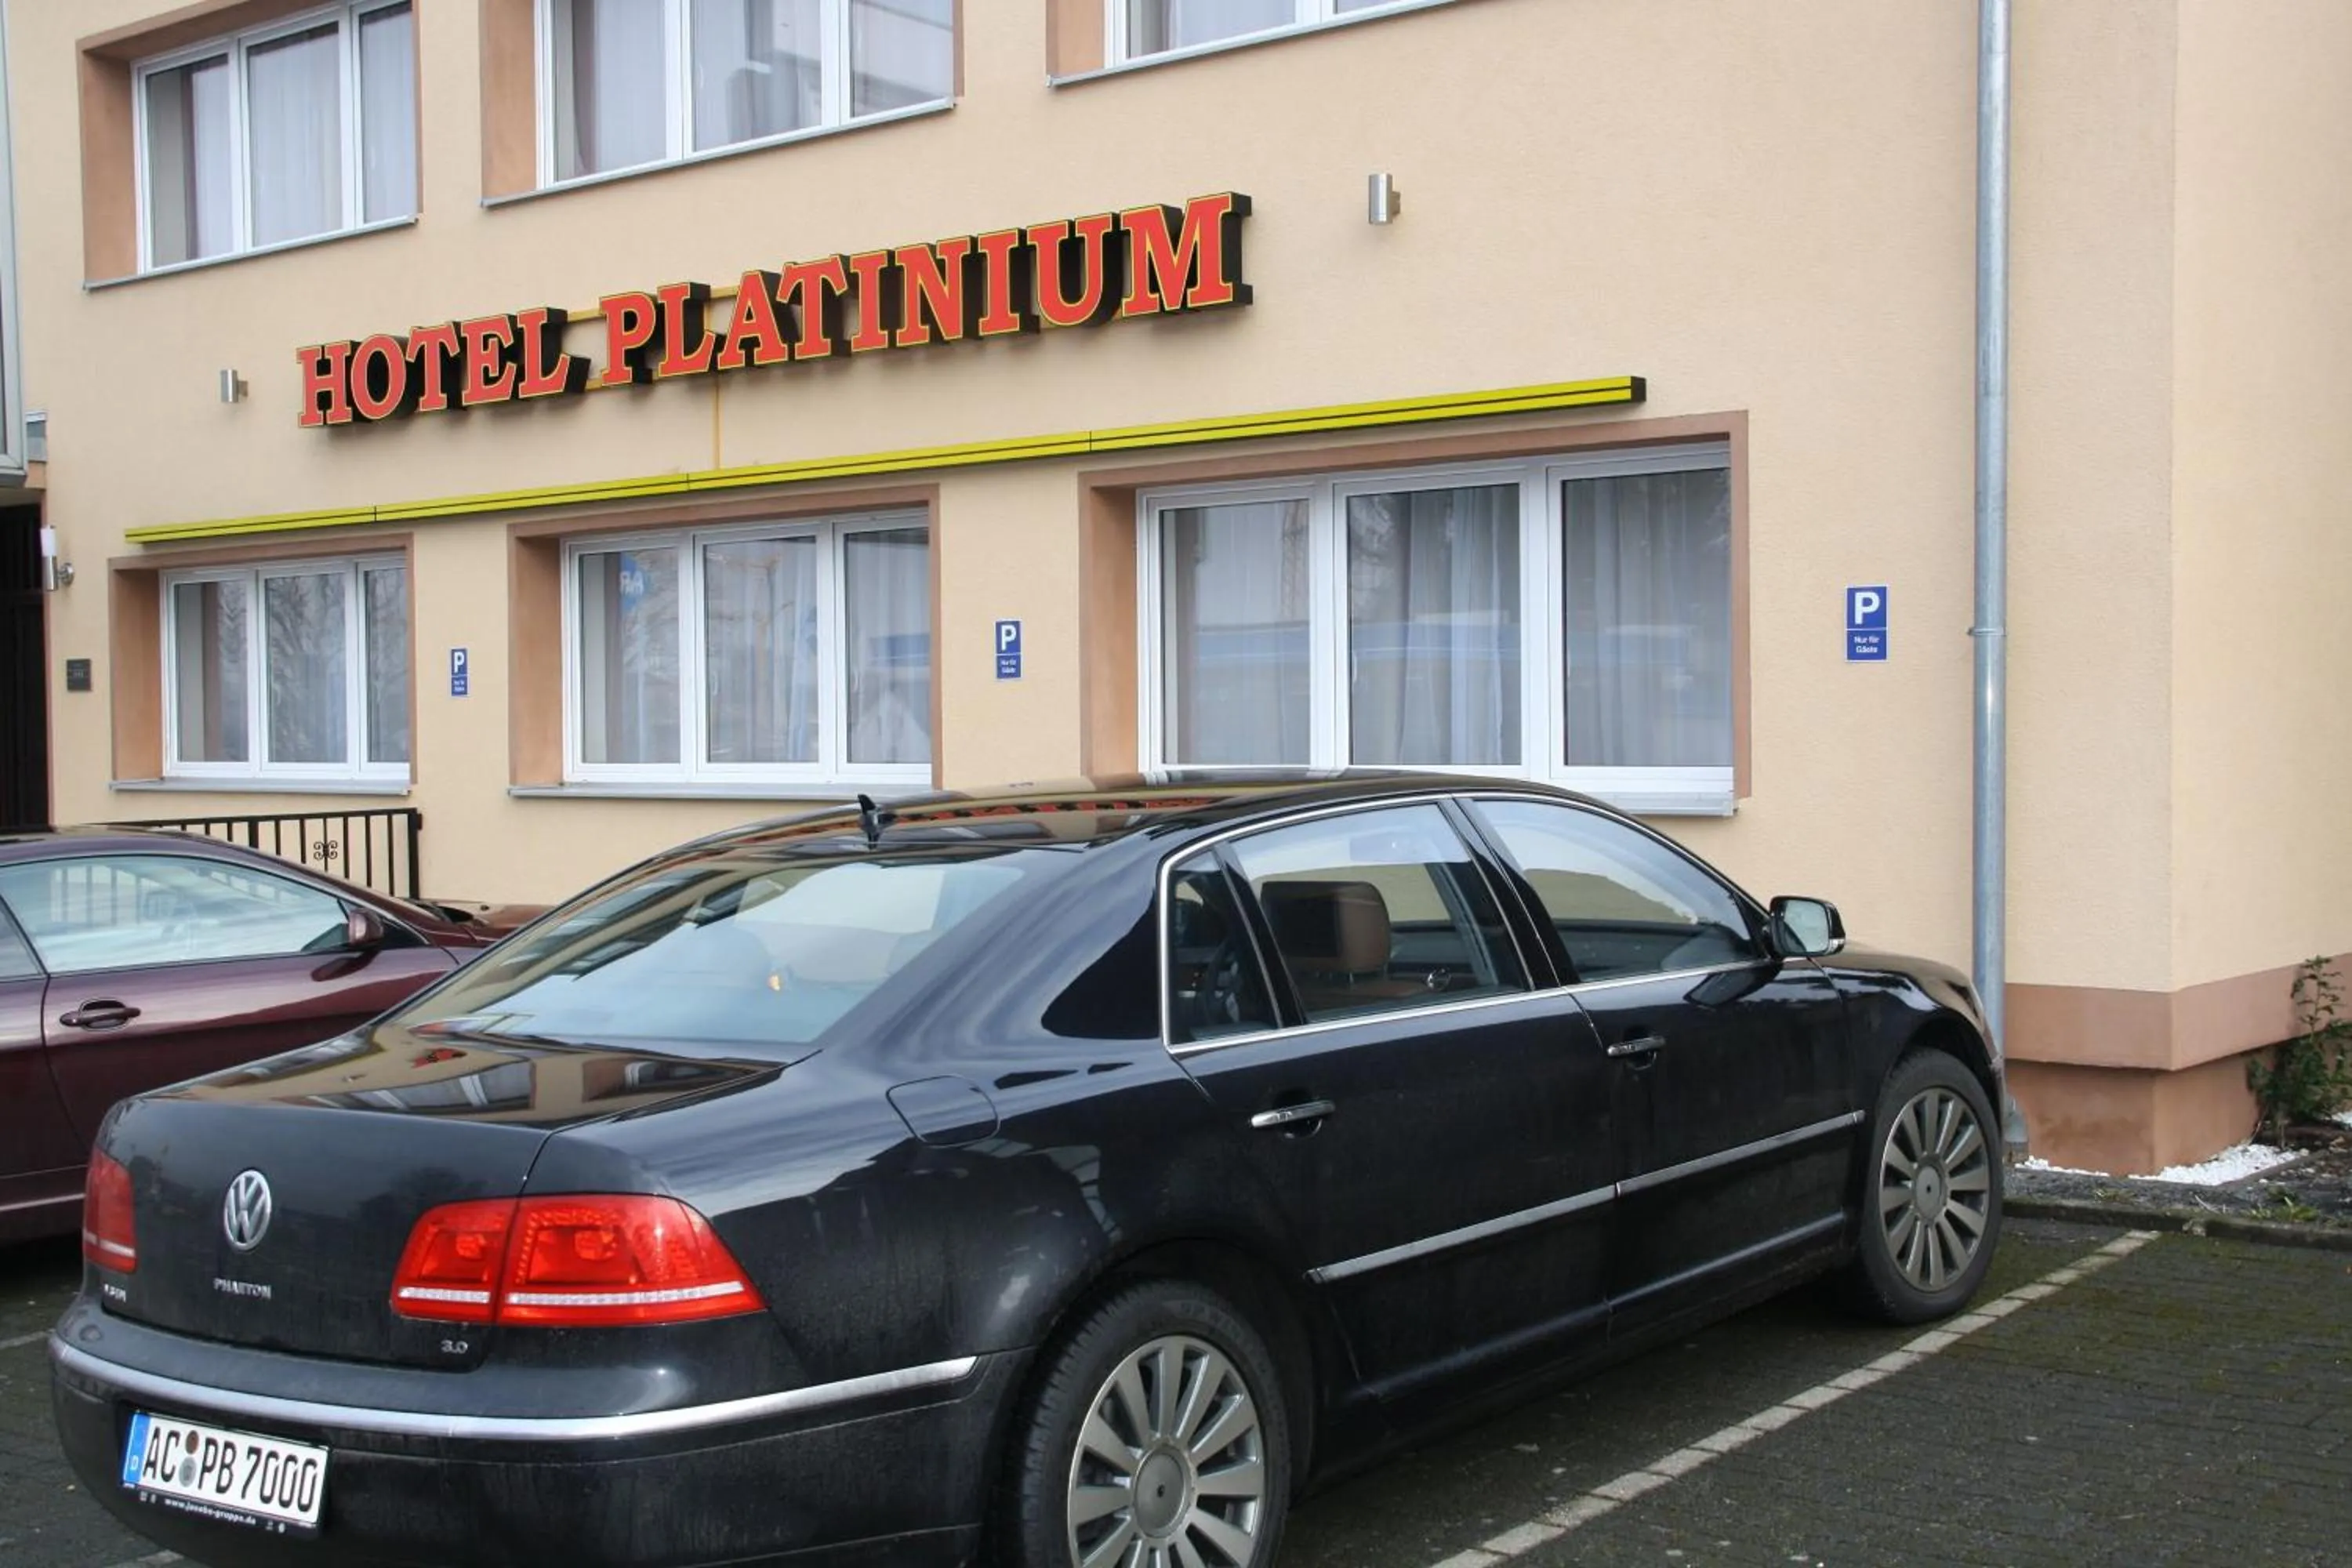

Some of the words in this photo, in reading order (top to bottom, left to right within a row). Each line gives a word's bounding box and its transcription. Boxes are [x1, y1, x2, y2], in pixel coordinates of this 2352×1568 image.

[296, 307, 572, 428] HOTEL
[599, 192, 1233, 386] PLATINIUM
[1854, 591, 1880, 625] P
[1001, 625, 1017, 651] P
[454, 652, 465, 673] P
[441, 1339, 468, 1354] 3.0
[142, 1426, 181, 1483] AC
[198, 1437, 238, 1494] PB
[241, 1445, 318, 1512] 7000
